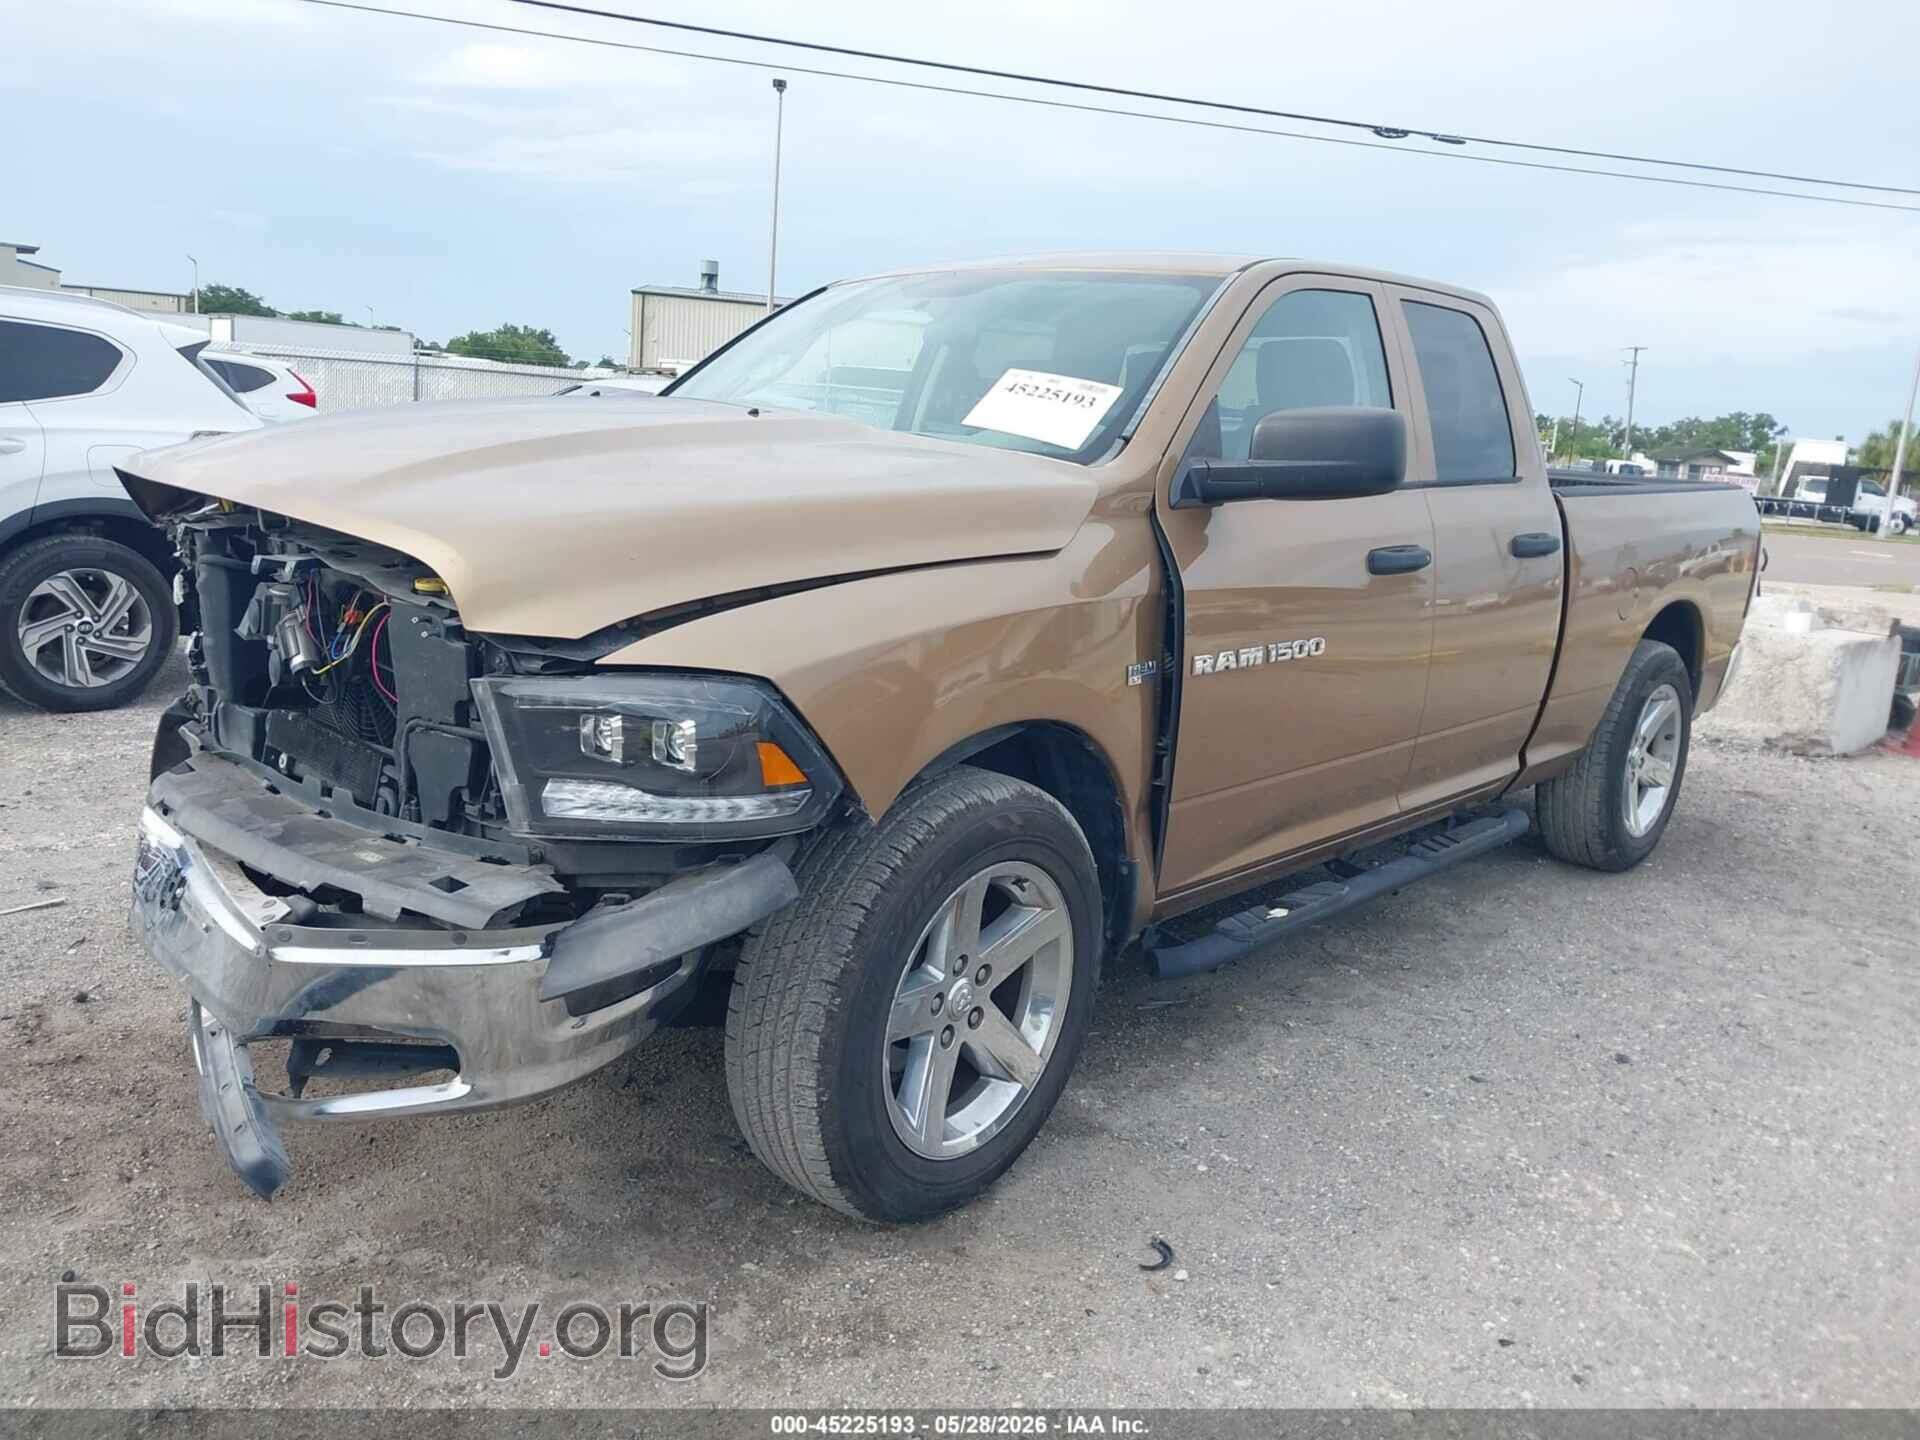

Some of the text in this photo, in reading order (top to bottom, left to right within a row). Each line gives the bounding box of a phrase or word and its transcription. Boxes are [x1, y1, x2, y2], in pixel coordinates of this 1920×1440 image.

[1005, 382, 1097, 408] 45225193
[1191, 636, 1327, 676] RAM 1500
